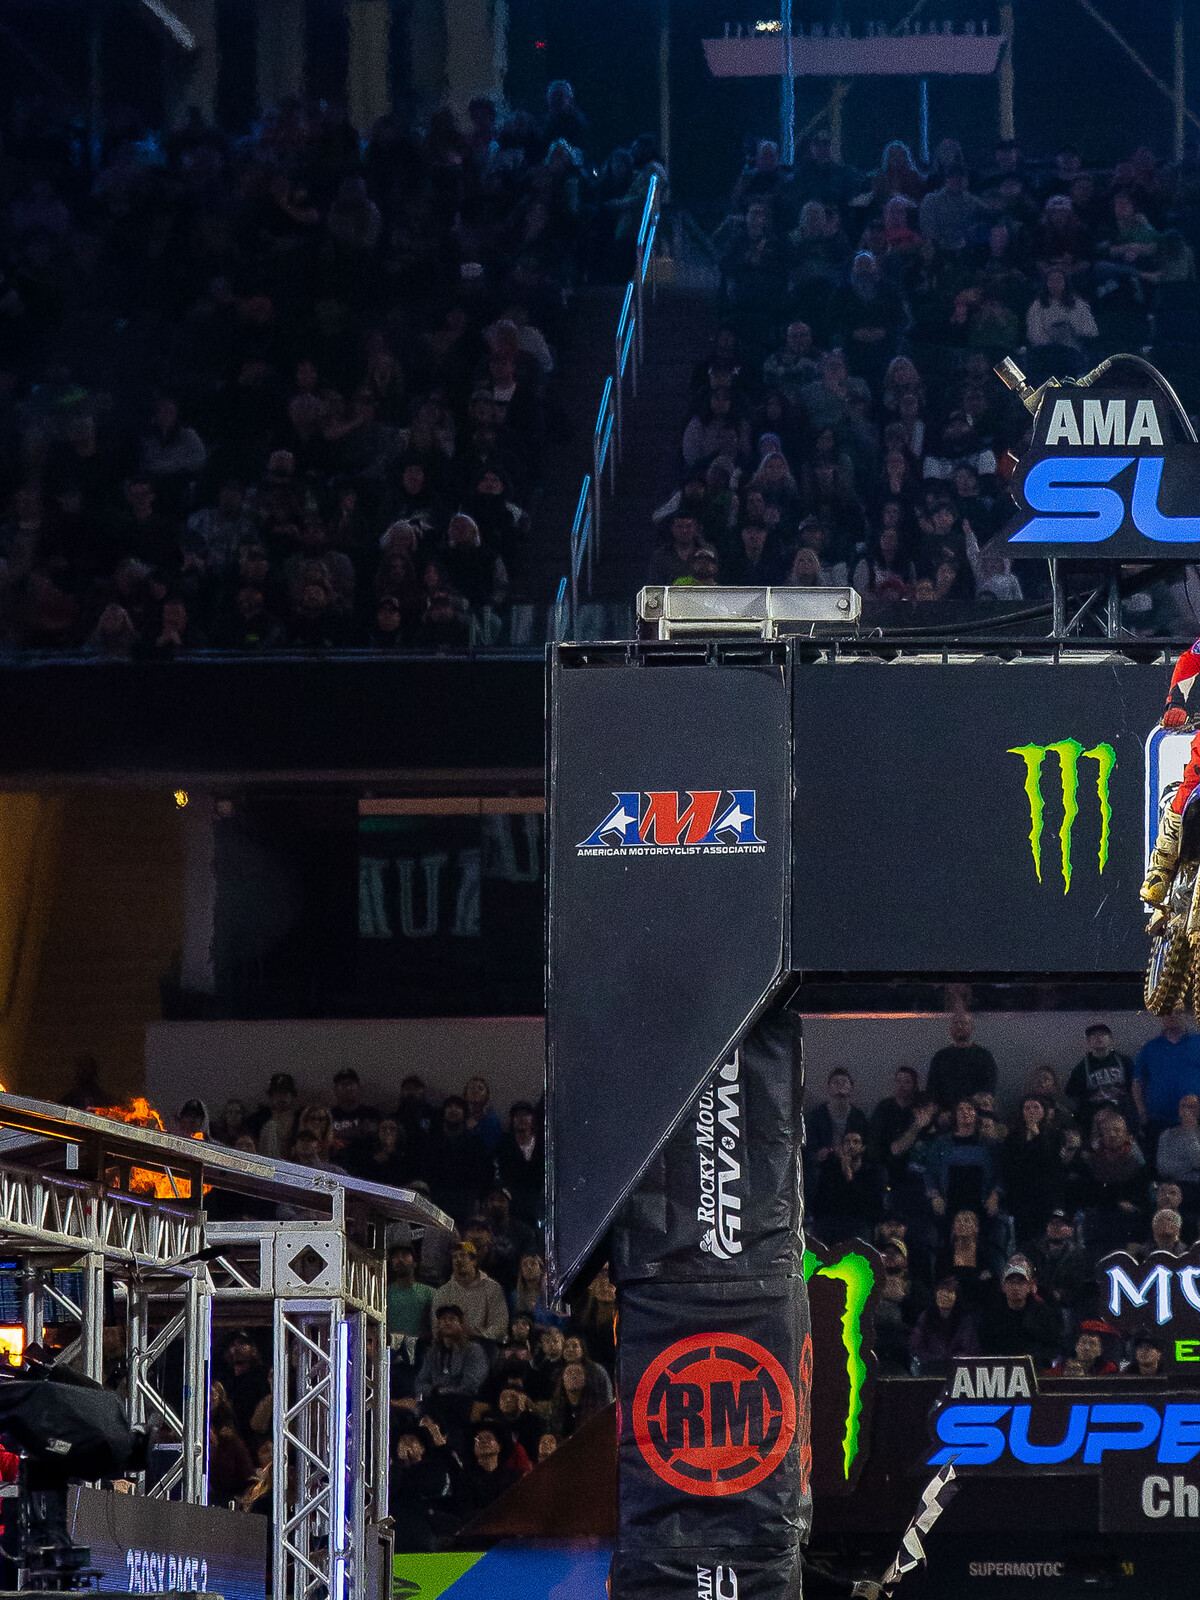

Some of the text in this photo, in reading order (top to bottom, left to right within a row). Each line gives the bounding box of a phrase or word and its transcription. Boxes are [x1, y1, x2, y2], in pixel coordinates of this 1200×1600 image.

[1045, 399, 1165, 446] AMA
[575, 789, 768, 847] AMA
[577, 845, 766, 857] AMERICAN MOTORCYCLIST ASSOCIATION
[696, 1083, 715, 1225] ROCKY MOU
[951, 1365, 1031, 1399] AMA
[665, 1378, 765, 1451] RM
